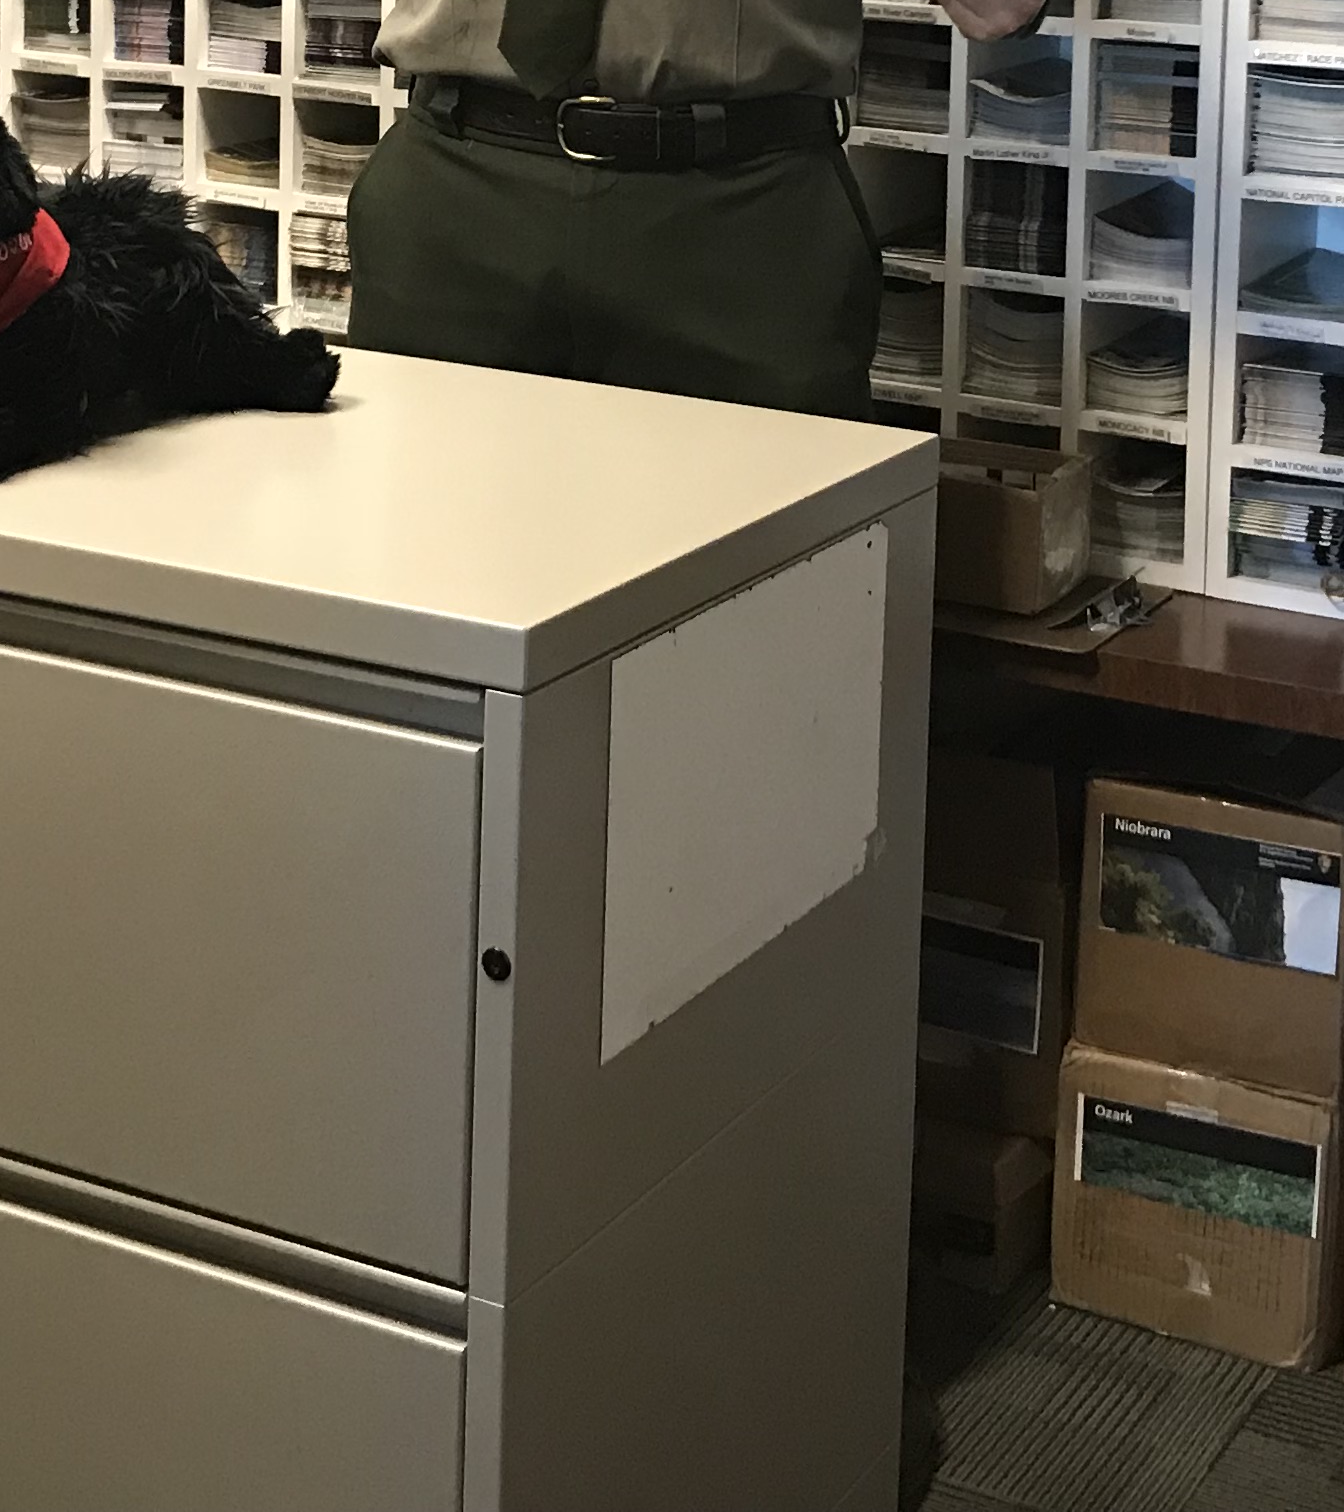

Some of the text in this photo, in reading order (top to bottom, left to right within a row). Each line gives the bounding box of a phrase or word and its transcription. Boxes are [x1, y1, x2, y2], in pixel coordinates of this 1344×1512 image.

[996, 150, 1020, 158] Luther
[1022, 151, 1040, 159] King
[1292, 192, 1332, 204] CAPITOL
[1088, 290, 1128, 301] MOORES
[1129, 293, 1159, 303] CREEK
[1098, 420, 1149, 434] MONOCACY
[1253, 457, 1344, 476] NPS NATIONAL MAP
[1114, 816, 1172, 841] Niobrara
[1094, 1103, 1134, 1126] Ozark
